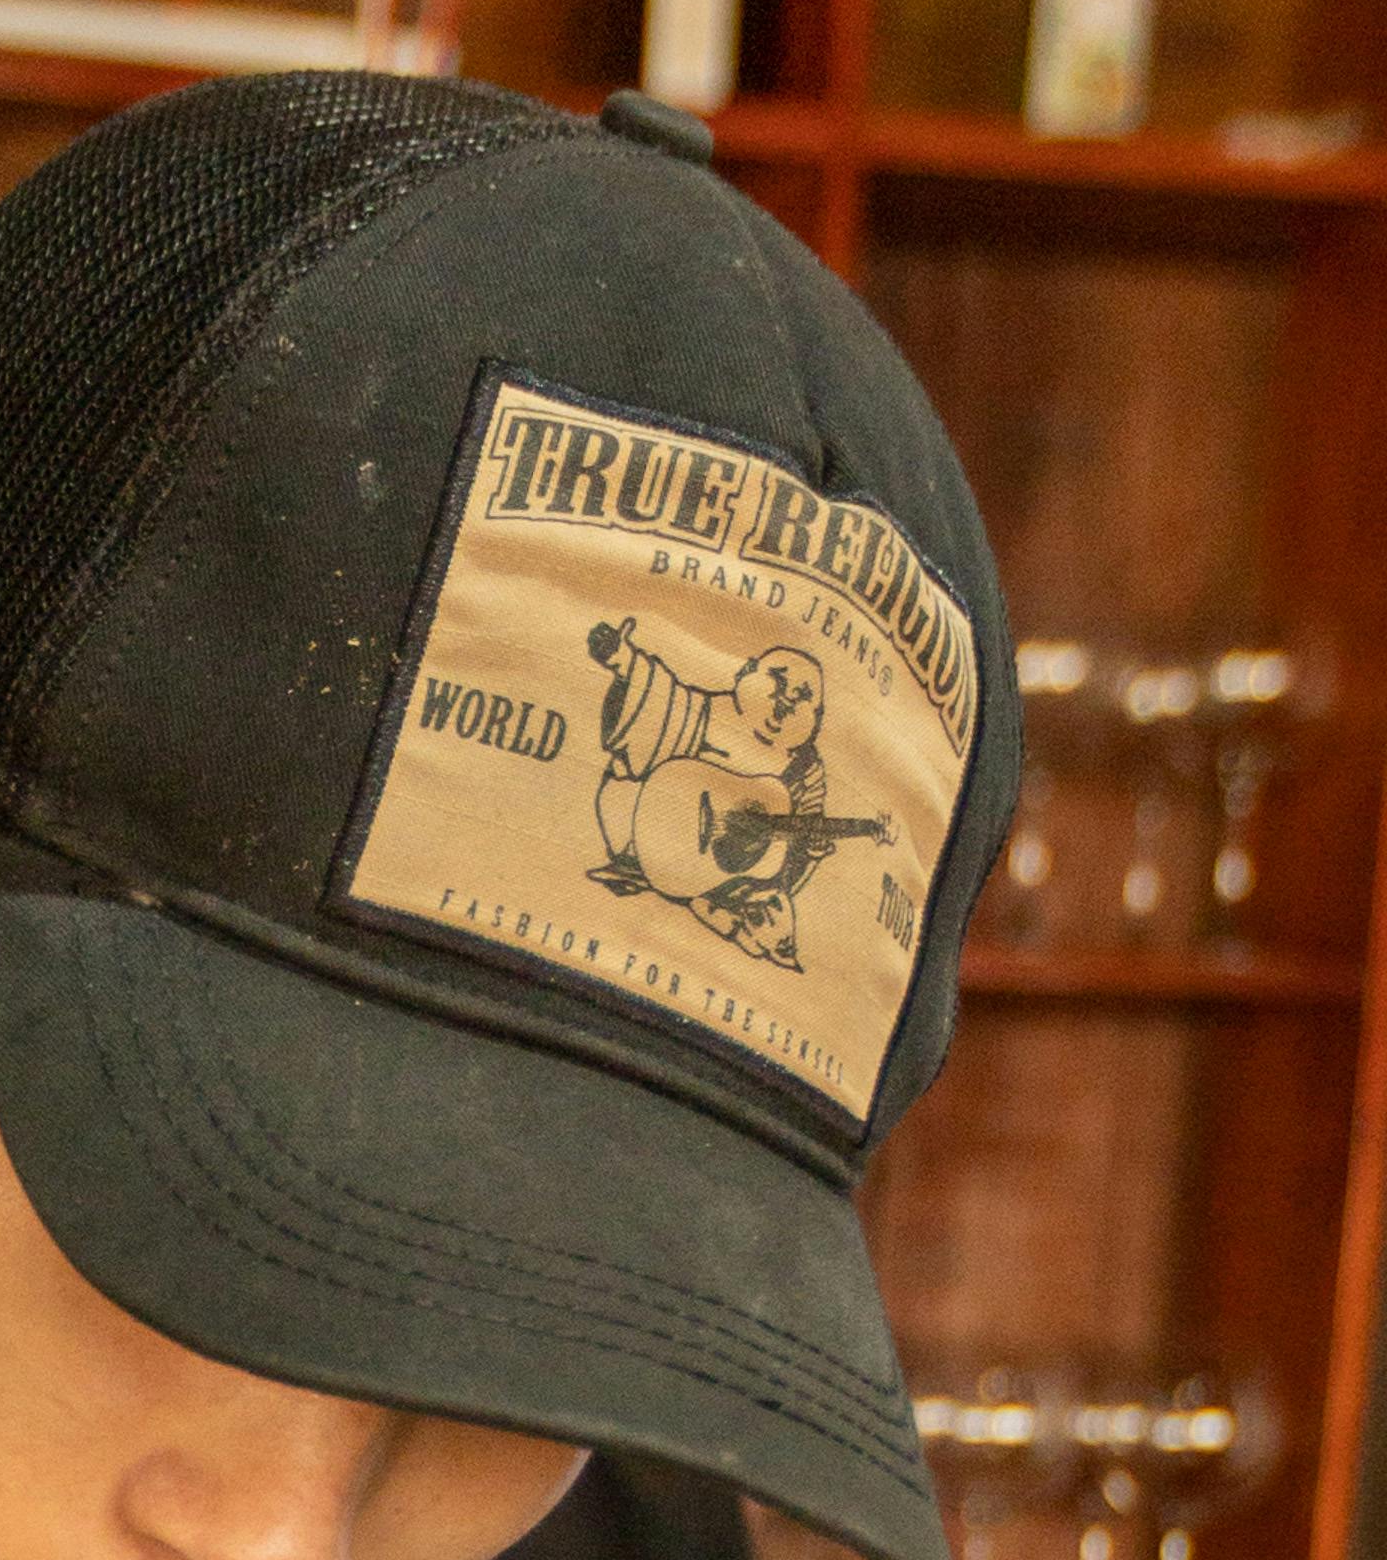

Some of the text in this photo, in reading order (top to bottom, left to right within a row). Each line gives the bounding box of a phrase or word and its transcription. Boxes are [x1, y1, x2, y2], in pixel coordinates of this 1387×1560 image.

[490, 409, 977, 754] TRUE RELIGION
[650, 549, 786, 610] BRAND
[419, 676, 568, 763] WORLD
[876, 871, 917, 949] TOUR
[438, 887, 600, 962] FASHION
[622, 953, 681, 996] FOR
[703, 988, 754, 1033] THE
